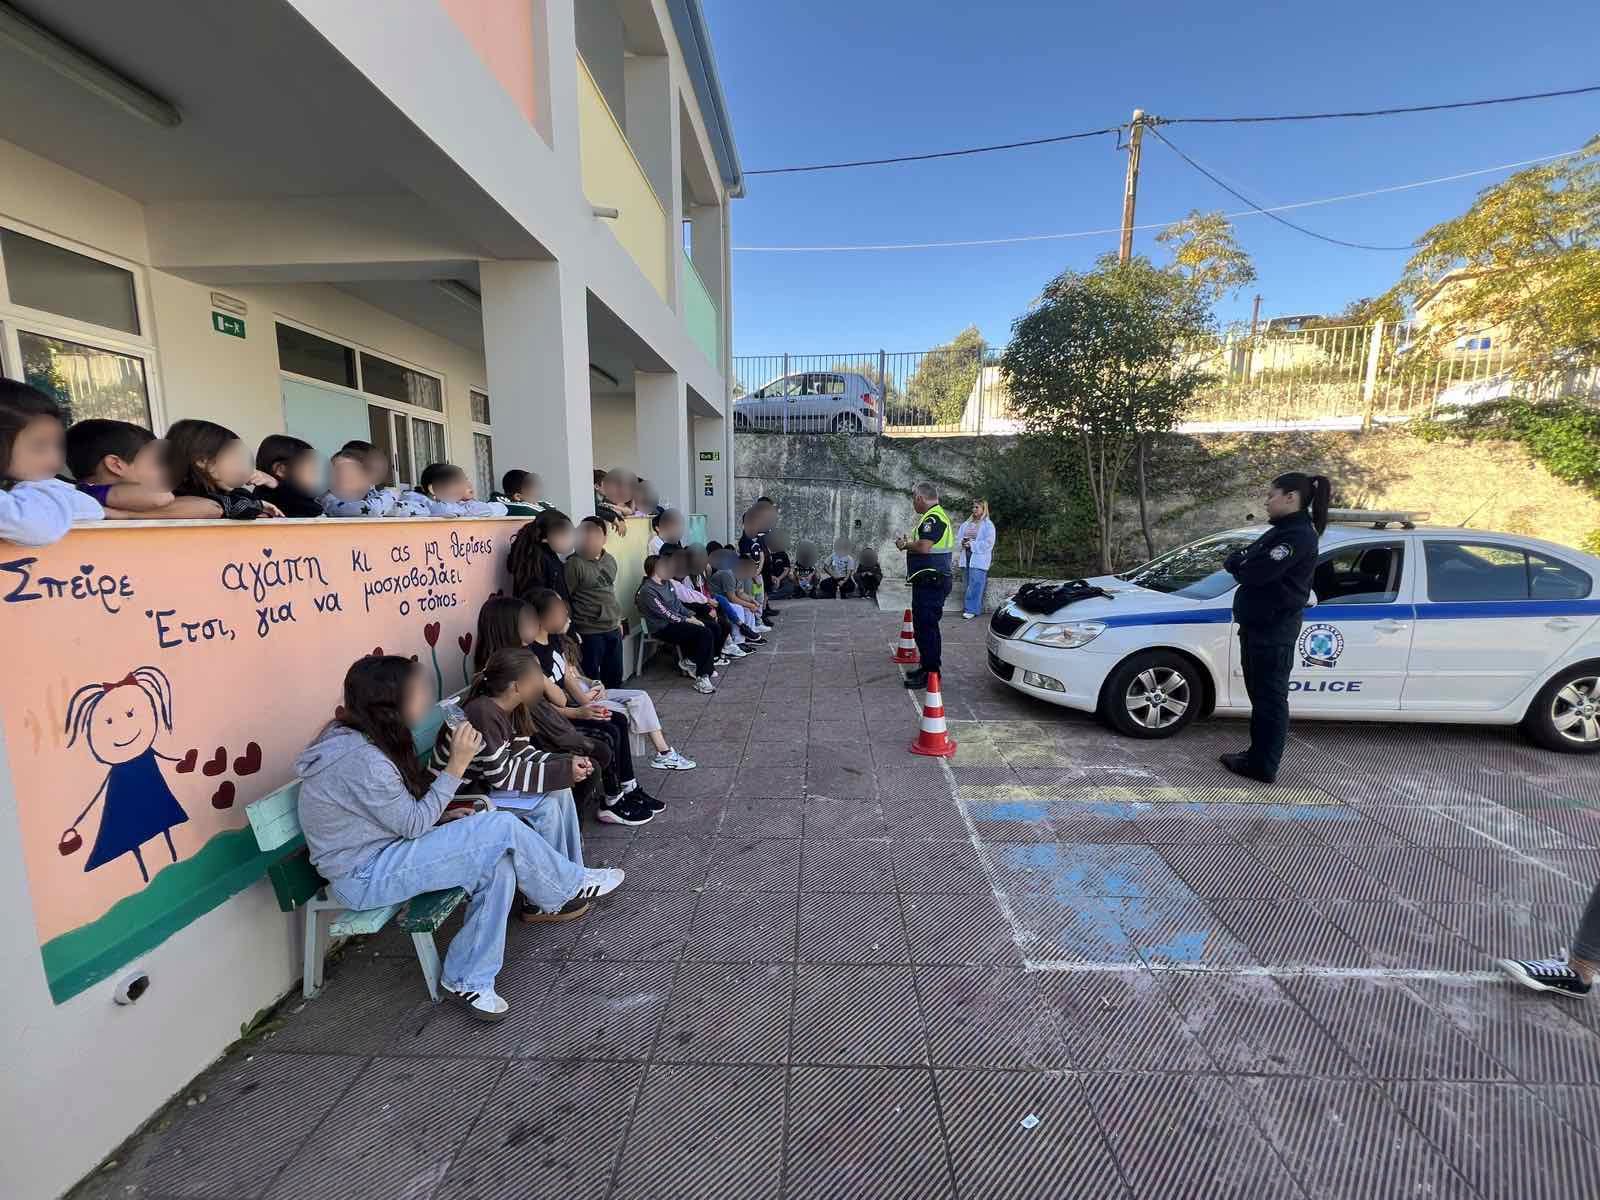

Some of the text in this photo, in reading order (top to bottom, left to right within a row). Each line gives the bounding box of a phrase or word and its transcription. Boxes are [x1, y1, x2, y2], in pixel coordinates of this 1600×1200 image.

[0, 556, 134, 614] Σπείρε
[221, 548, 329, 603] αγάπη
[391, 545, 411, 563] ας
[424, 541, 443, 566] μη
[450, 531, 492, 565] θερίσεις
[145, 562, 462, 648] Έτσι, για να μοσχοβολάει
[400, 600, 410, 616] ο
[1287, 680, 1363, 692] OLICE
